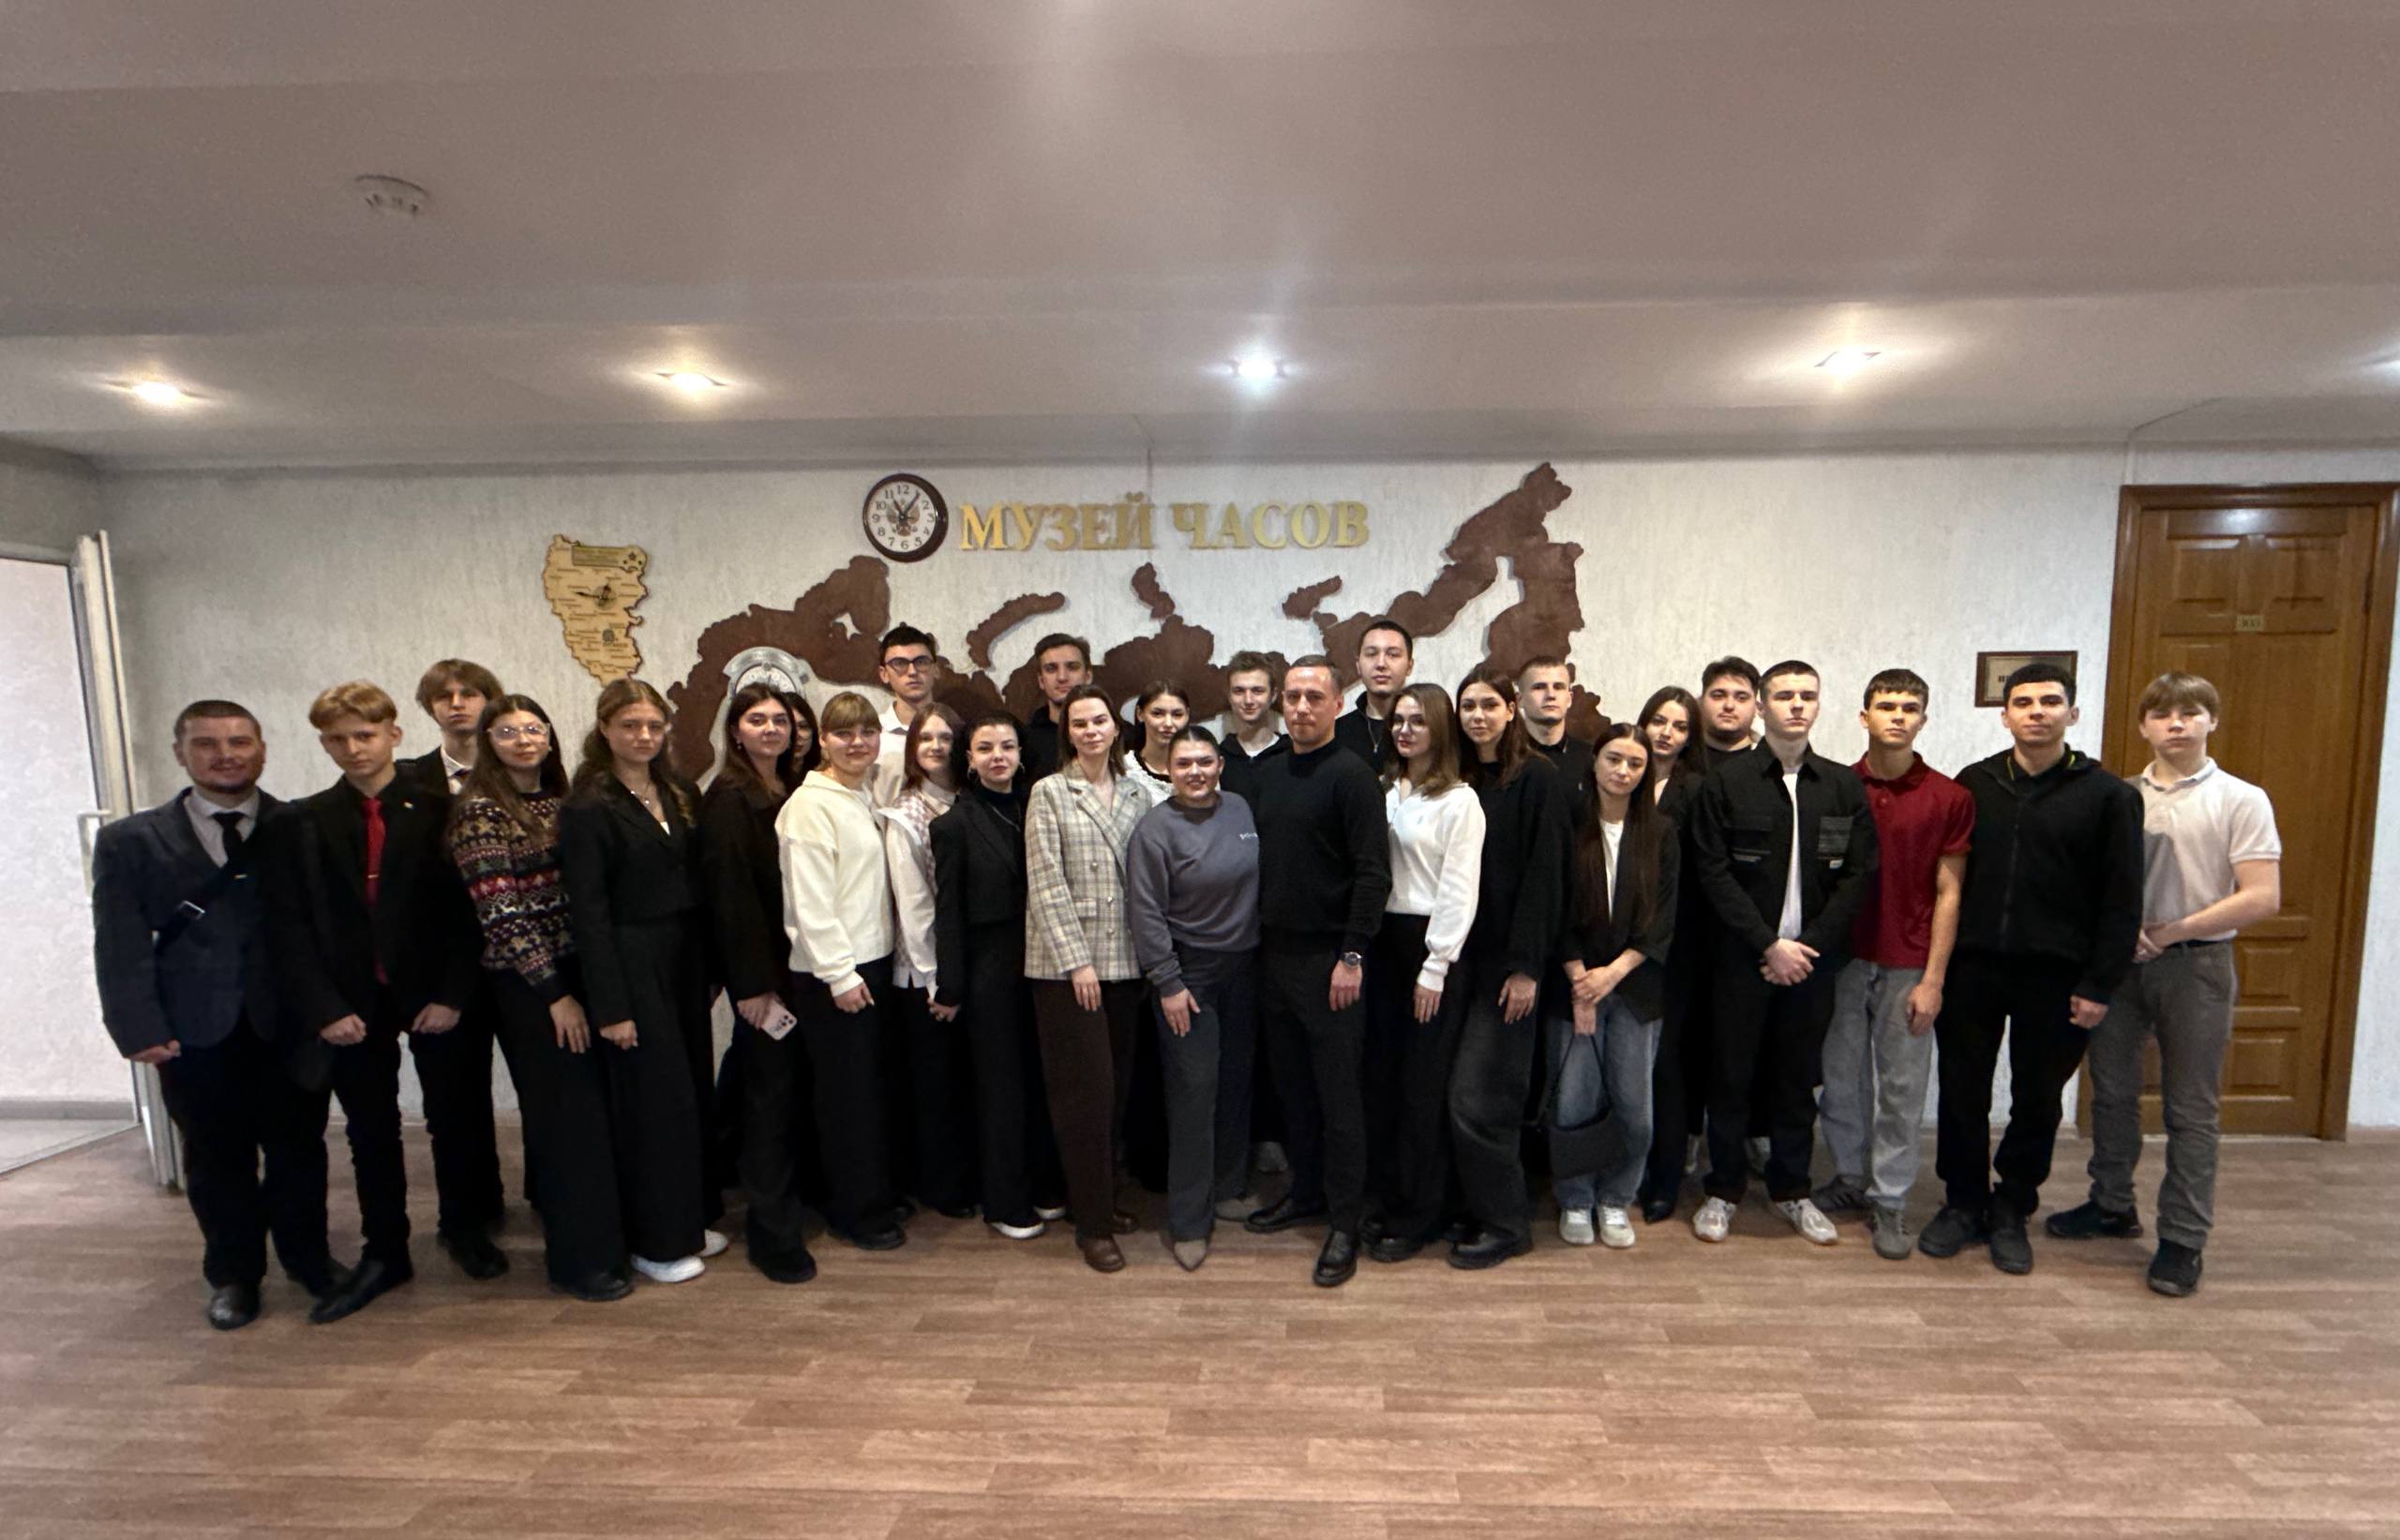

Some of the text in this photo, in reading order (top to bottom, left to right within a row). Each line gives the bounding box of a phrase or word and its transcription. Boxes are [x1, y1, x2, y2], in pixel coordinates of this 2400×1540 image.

[886, 490, 893, 499] 11
[897, 485, 909, 495] 12
[877, 501, 886, 510] 10
[922, 501, 930, 510] 2
[872, 515, 879, 523] 9
[927, 514, 934, 523] 3
[959, 492, 1370, 550] МУЗЕЙ ЧАСОВ
[878, 528, 885, 536] 8
[923, 527, 930, 535] 4
[889, 537, 895, 546] 7
[901, 541, 908, 550] 6
[915, 537, 922, 546] 5
